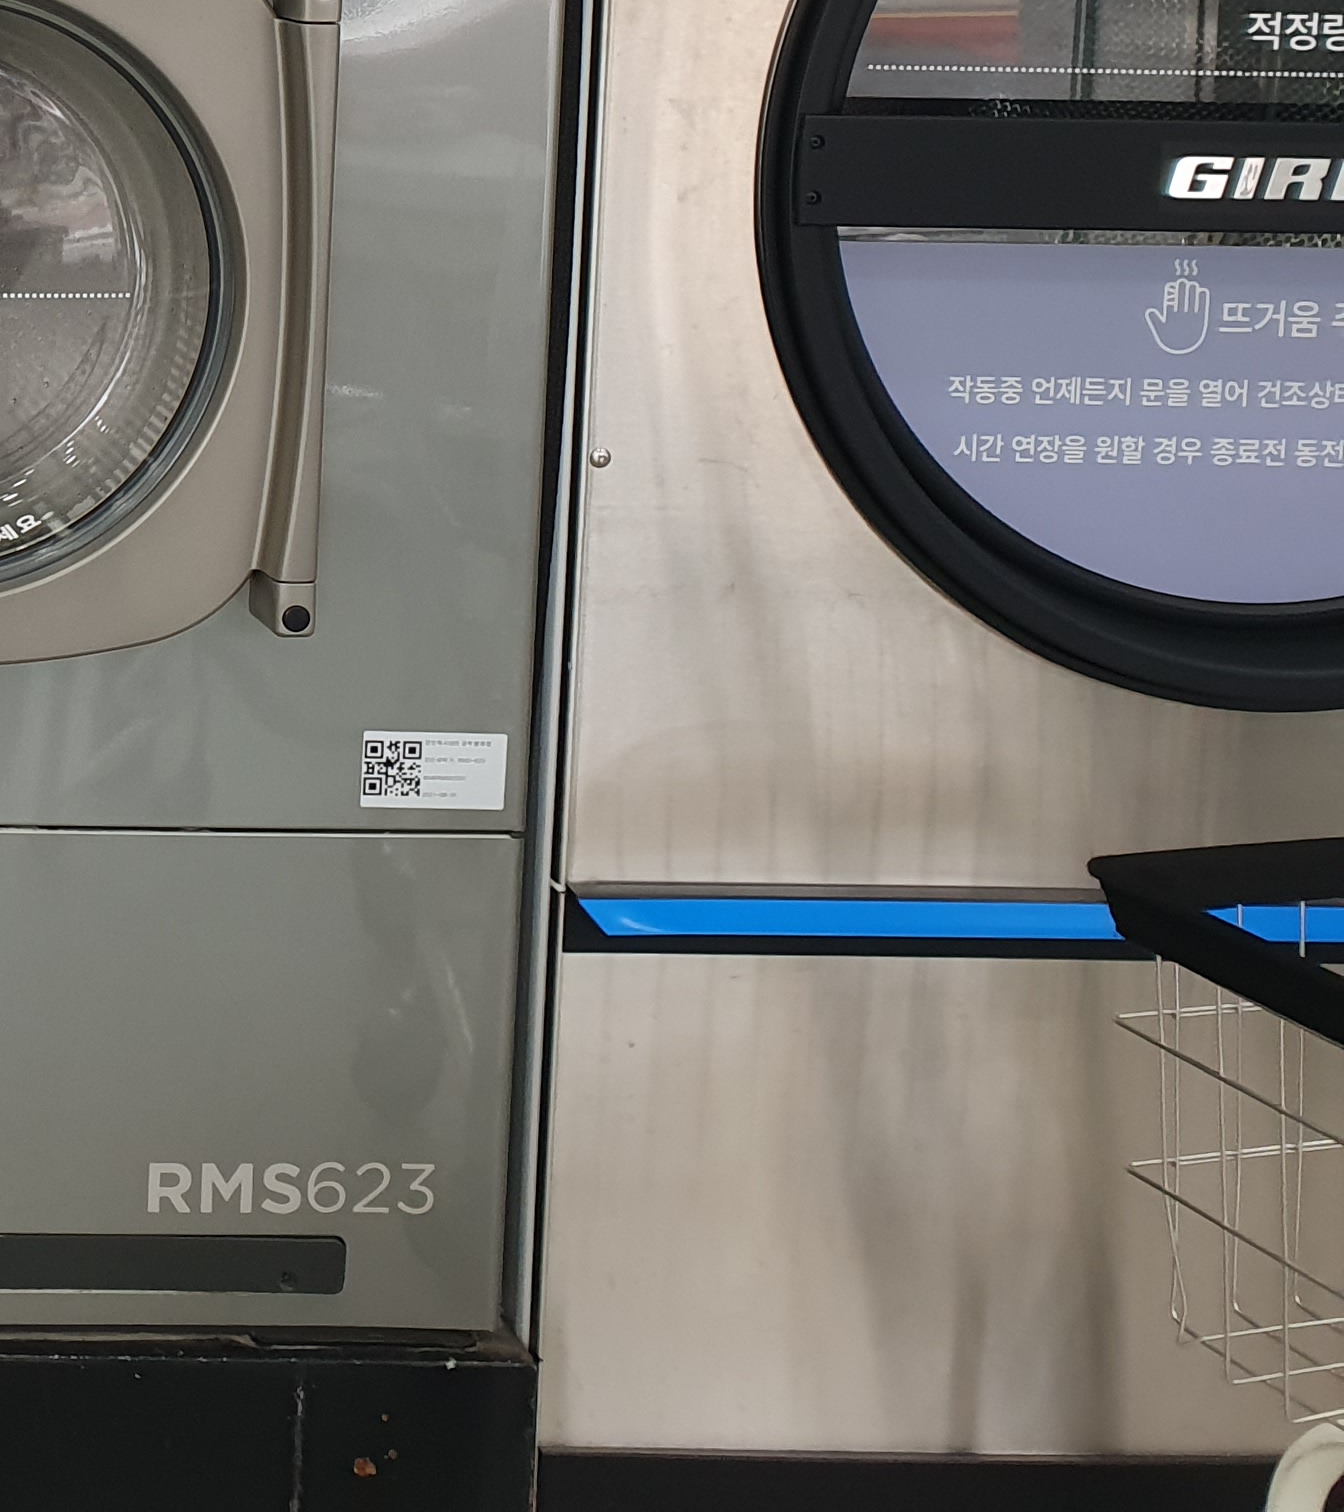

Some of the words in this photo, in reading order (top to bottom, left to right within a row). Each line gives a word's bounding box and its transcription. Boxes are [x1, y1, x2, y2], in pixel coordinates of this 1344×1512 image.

[1165, 156, 1344, 200] GIR
[1219, 300, 1321, 337] 뜨거움
[949, 376, 1023, 405] 작동중
[1032, 377, 1131, 405] 언제든지
[1140, 378, 1190, 407] 문을
[1199, 379, 1248, 407] 열어
[954, 434, 1004, 463] 시간
[1012, 435, 1086, 464] 연장을
[1094, 436, 1145, 465] 원할
[1153, 437, 1202, 465] 경우
[1210, 439, 1286, 467] 종료전
[148, 1162, 435, 1215] RMS623
